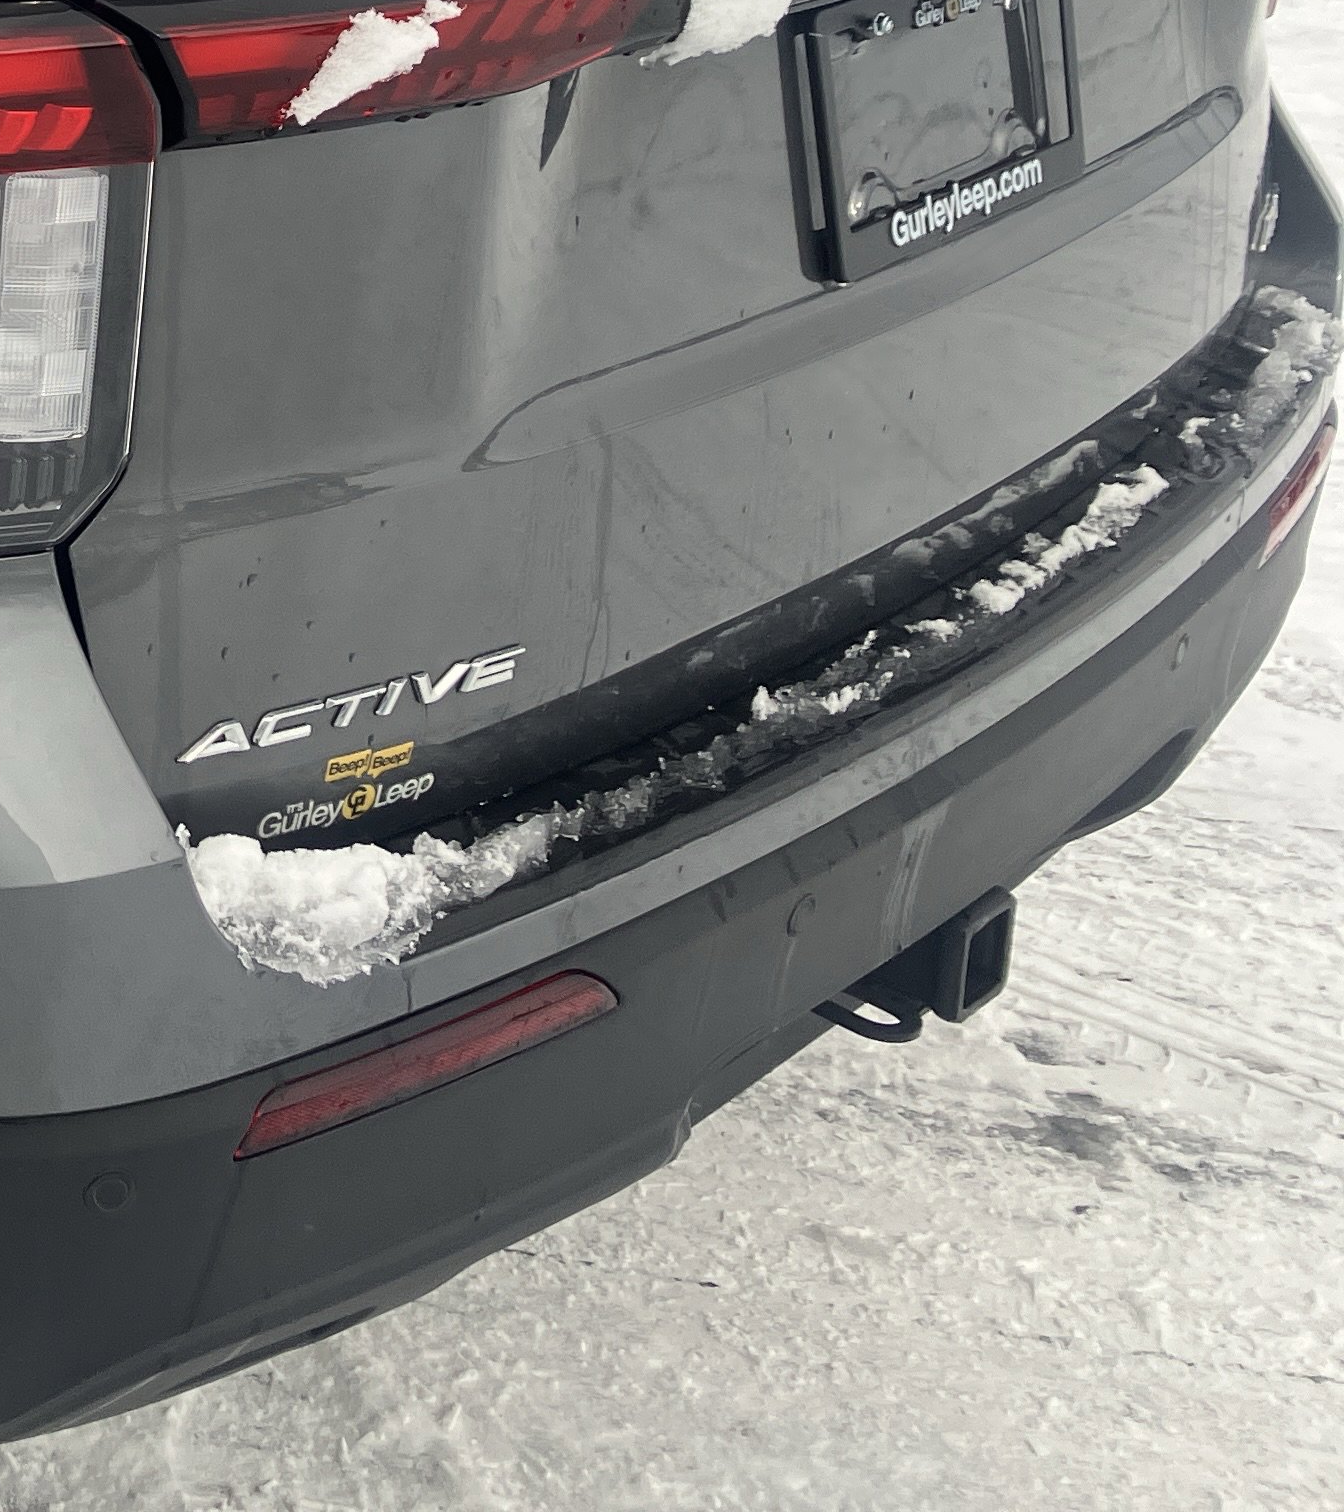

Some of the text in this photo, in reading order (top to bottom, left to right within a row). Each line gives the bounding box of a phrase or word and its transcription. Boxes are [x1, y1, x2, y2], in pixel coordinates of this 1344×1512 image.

[890, 158, 1043, 246] Gurleyleep.com
[175, 644, 526, 764] ACTIVE
[328, 747, 412, 776] Beep! Beep!
[258, 799, 344, 838] Gurley
[374, 773, 435, 808] Leep
